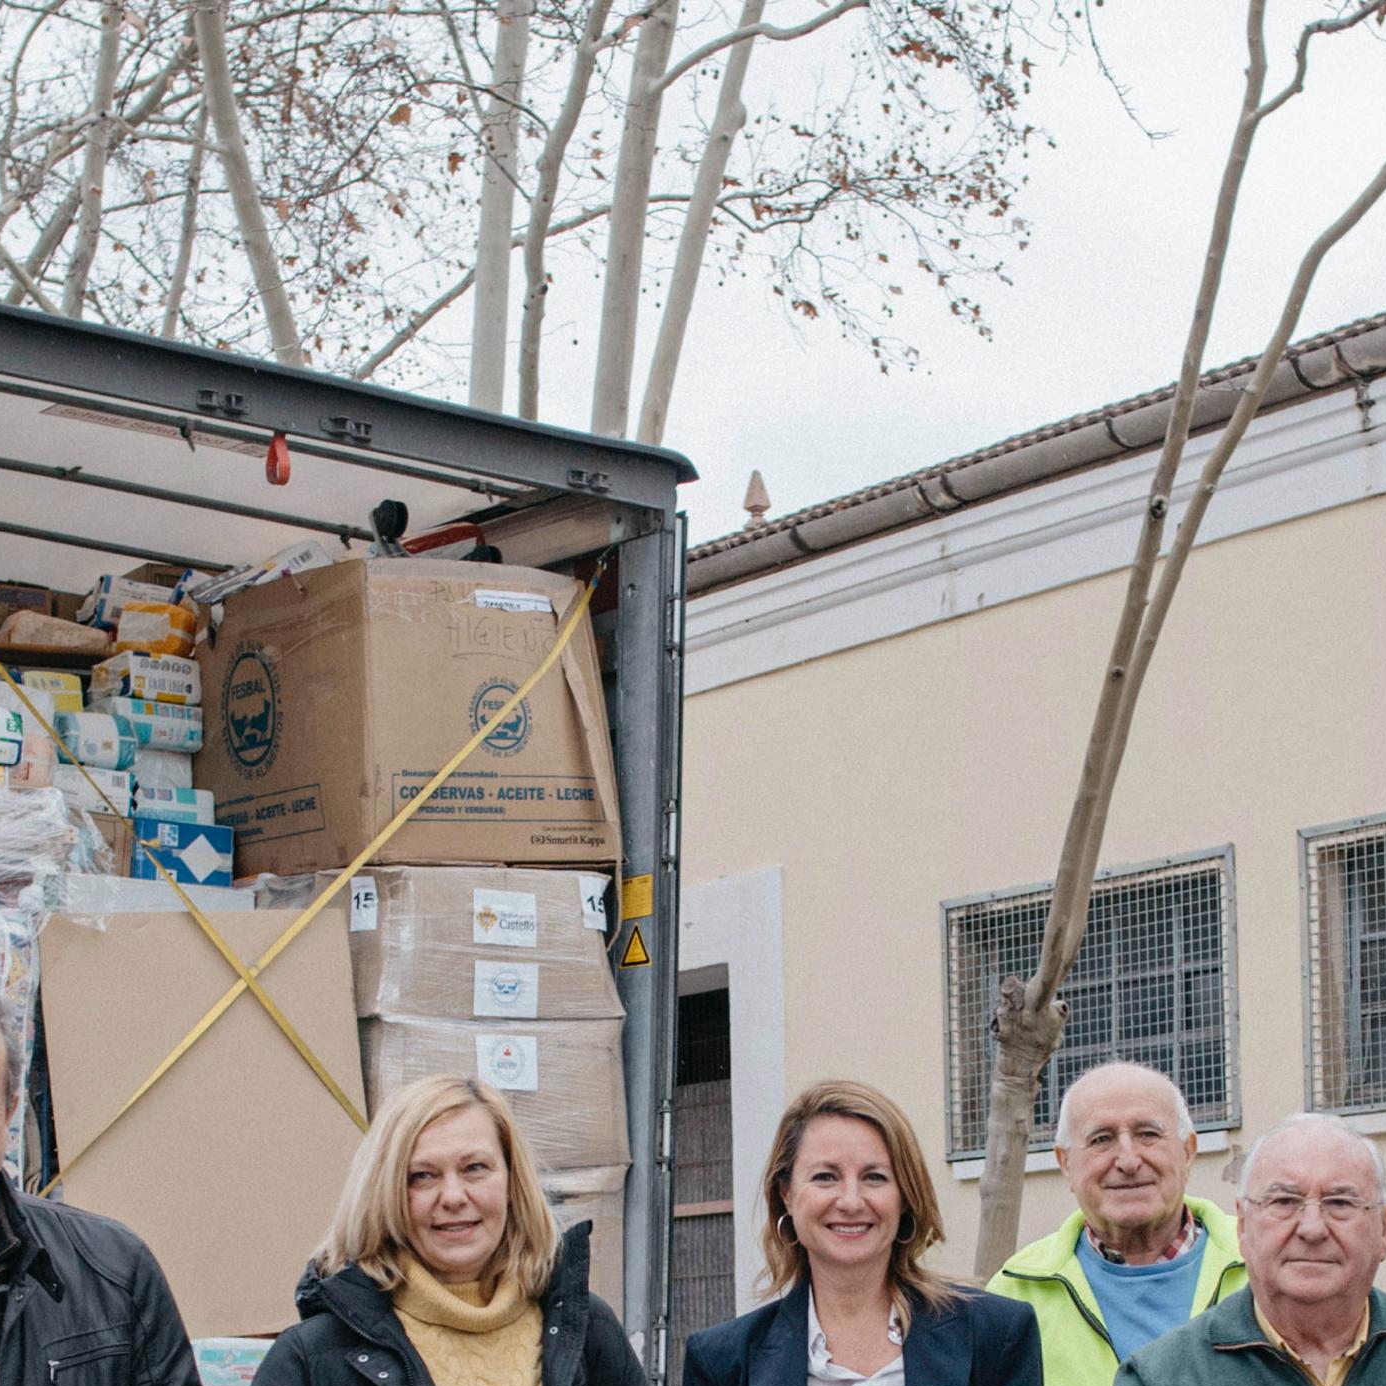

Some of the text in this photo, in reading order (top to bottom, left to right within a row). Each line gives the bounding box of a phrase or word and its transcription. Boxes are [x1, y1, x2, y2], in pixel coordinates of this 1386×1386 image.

[230, 679, 267, 700] FESBAL
[399, 785, 486, 801] COSERVAS
[496, 786, 546, 801] ACEITE
[556, 787, 596, 802] LECHE
[579, 834, 606, 848] Kappa
